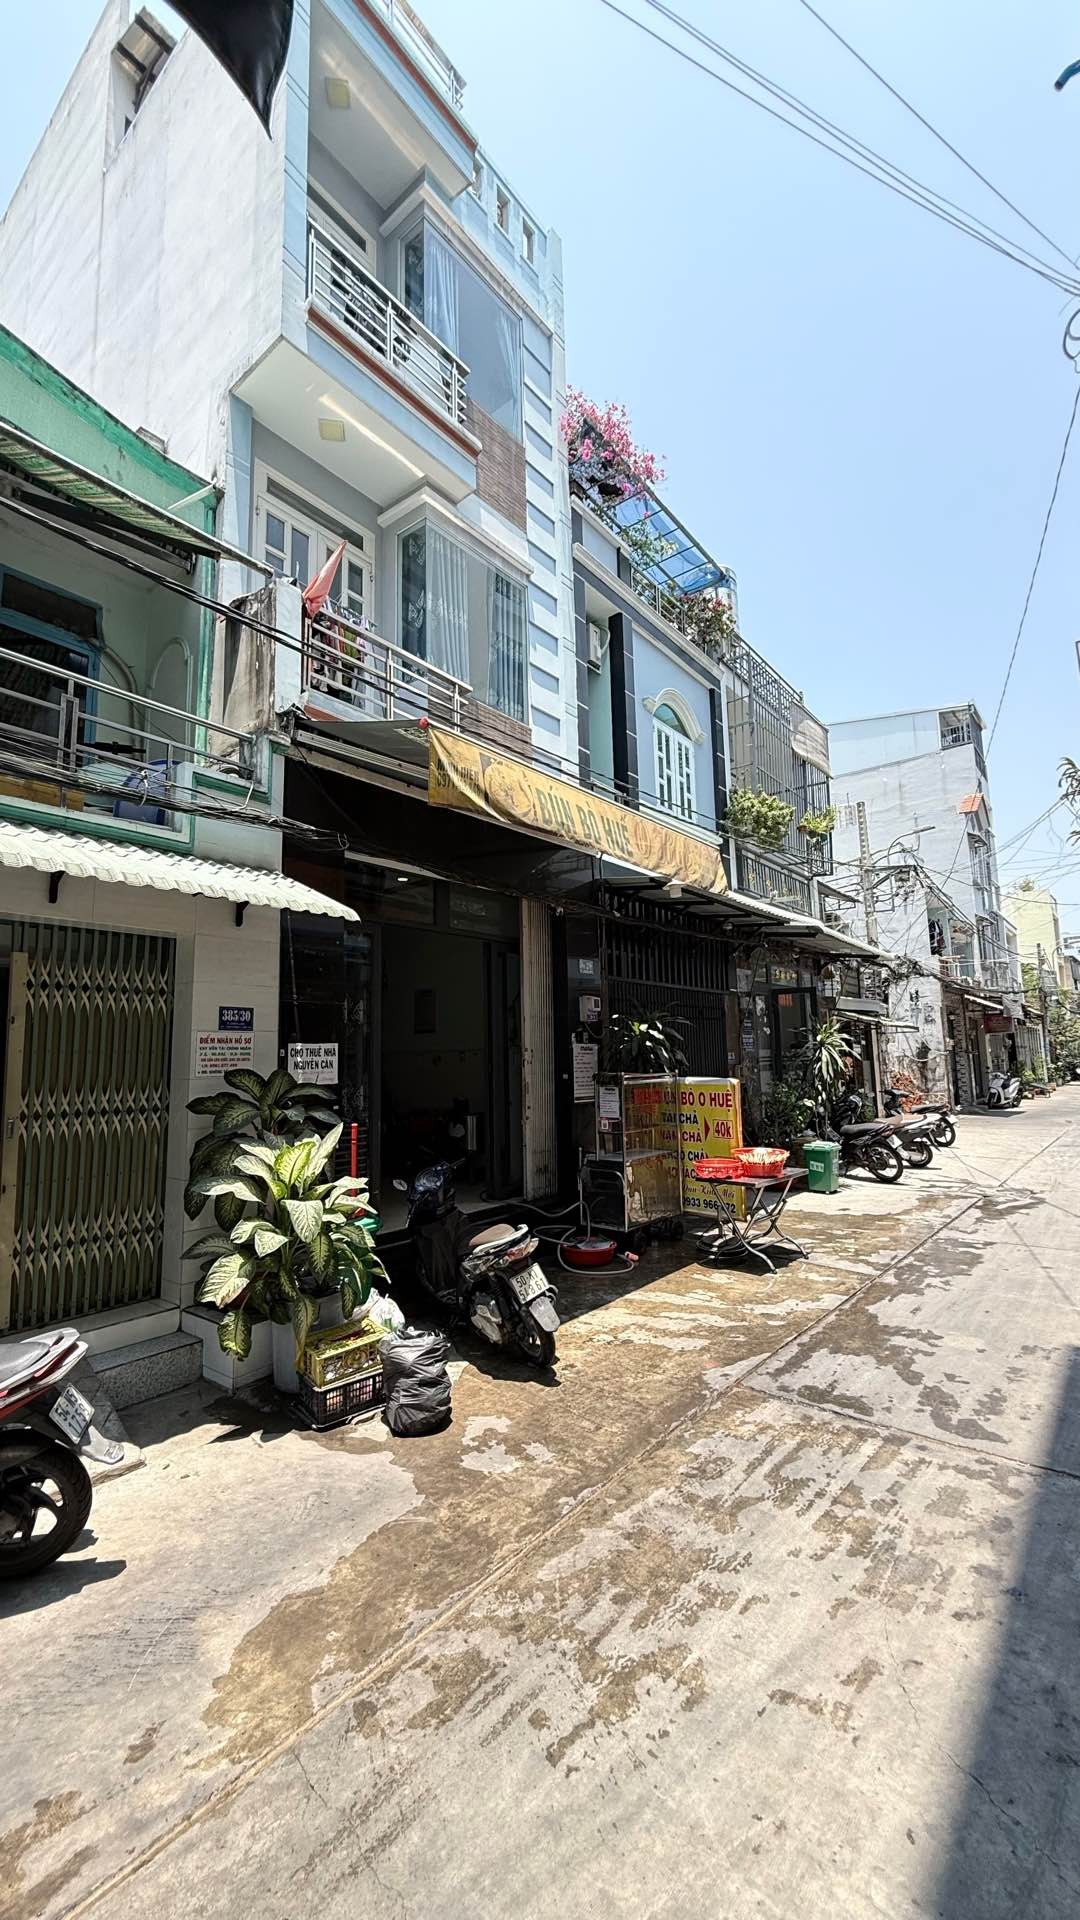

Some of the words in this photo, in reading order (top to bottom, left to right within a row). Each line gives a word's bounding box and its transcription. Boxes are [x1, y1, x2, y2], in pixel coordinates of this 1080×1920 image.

[535, 785, 577, 835] BÚN
[576, 800, 601, 845] BÒ
[290, 1047, 304, 1058] CHO
[305, 1045, 322, 1057] THUÊ
[293, 1058, 319, 1070] NGUYÊN
[681, 1088, 695, 1105] BÒ
[698, 1091, 706, 1107] O
[714, 1121, 732, 1138] 40k
